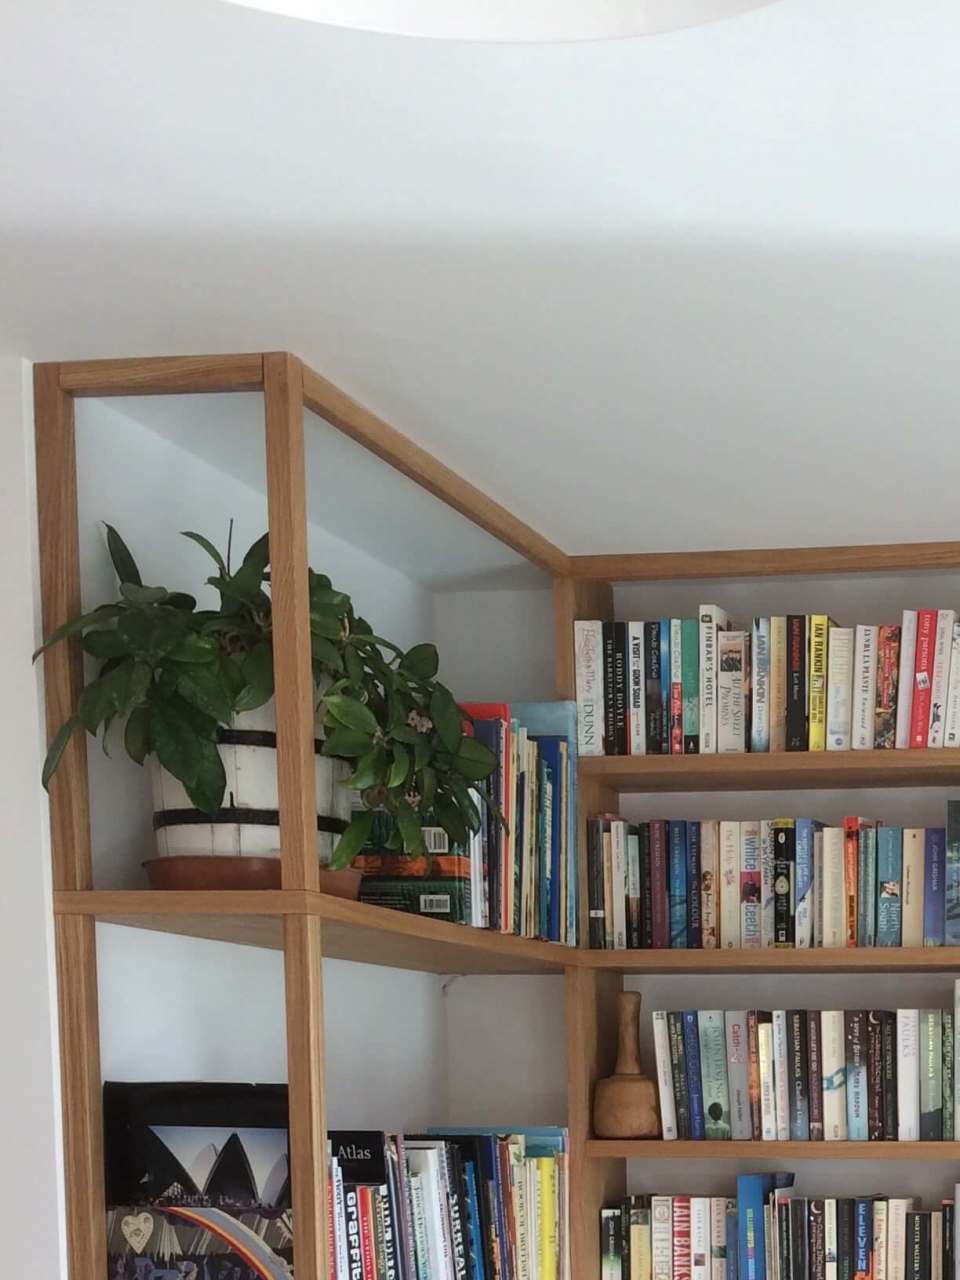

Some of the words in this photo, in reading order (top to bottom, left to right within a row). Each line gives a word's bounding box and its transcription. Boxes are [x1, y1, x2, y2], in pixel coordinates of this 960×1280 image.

[814, 624, 824, 640] IAN
[920, 614, 930, 635] tony
[632, 642, 640, 659] VISIT
[705, 626, 713, 673] FINBAR'S
[814, 641, 824, 673] RANKIN
[919, 636, 929, 670] parsons
[616, 653, 625, 689] RODDY
[632, 669, 641, 687] GOON
[632, 688, 641, 709] SQUAD
[705, 677, 713, 707] HOTEL
[583, 704, 595, 746] DUNN
[616, 692, 625, 729] DOYLE
[745, 836, 758, 870] white
[745, 904, 758, 936] teeth
[880, 902, 890, 932] South
[902, 1015, 913, 1058] FAULKS
[337, 1143, 372, 1160] Atlas
[673, 1201, 690, 1231] IAIN
